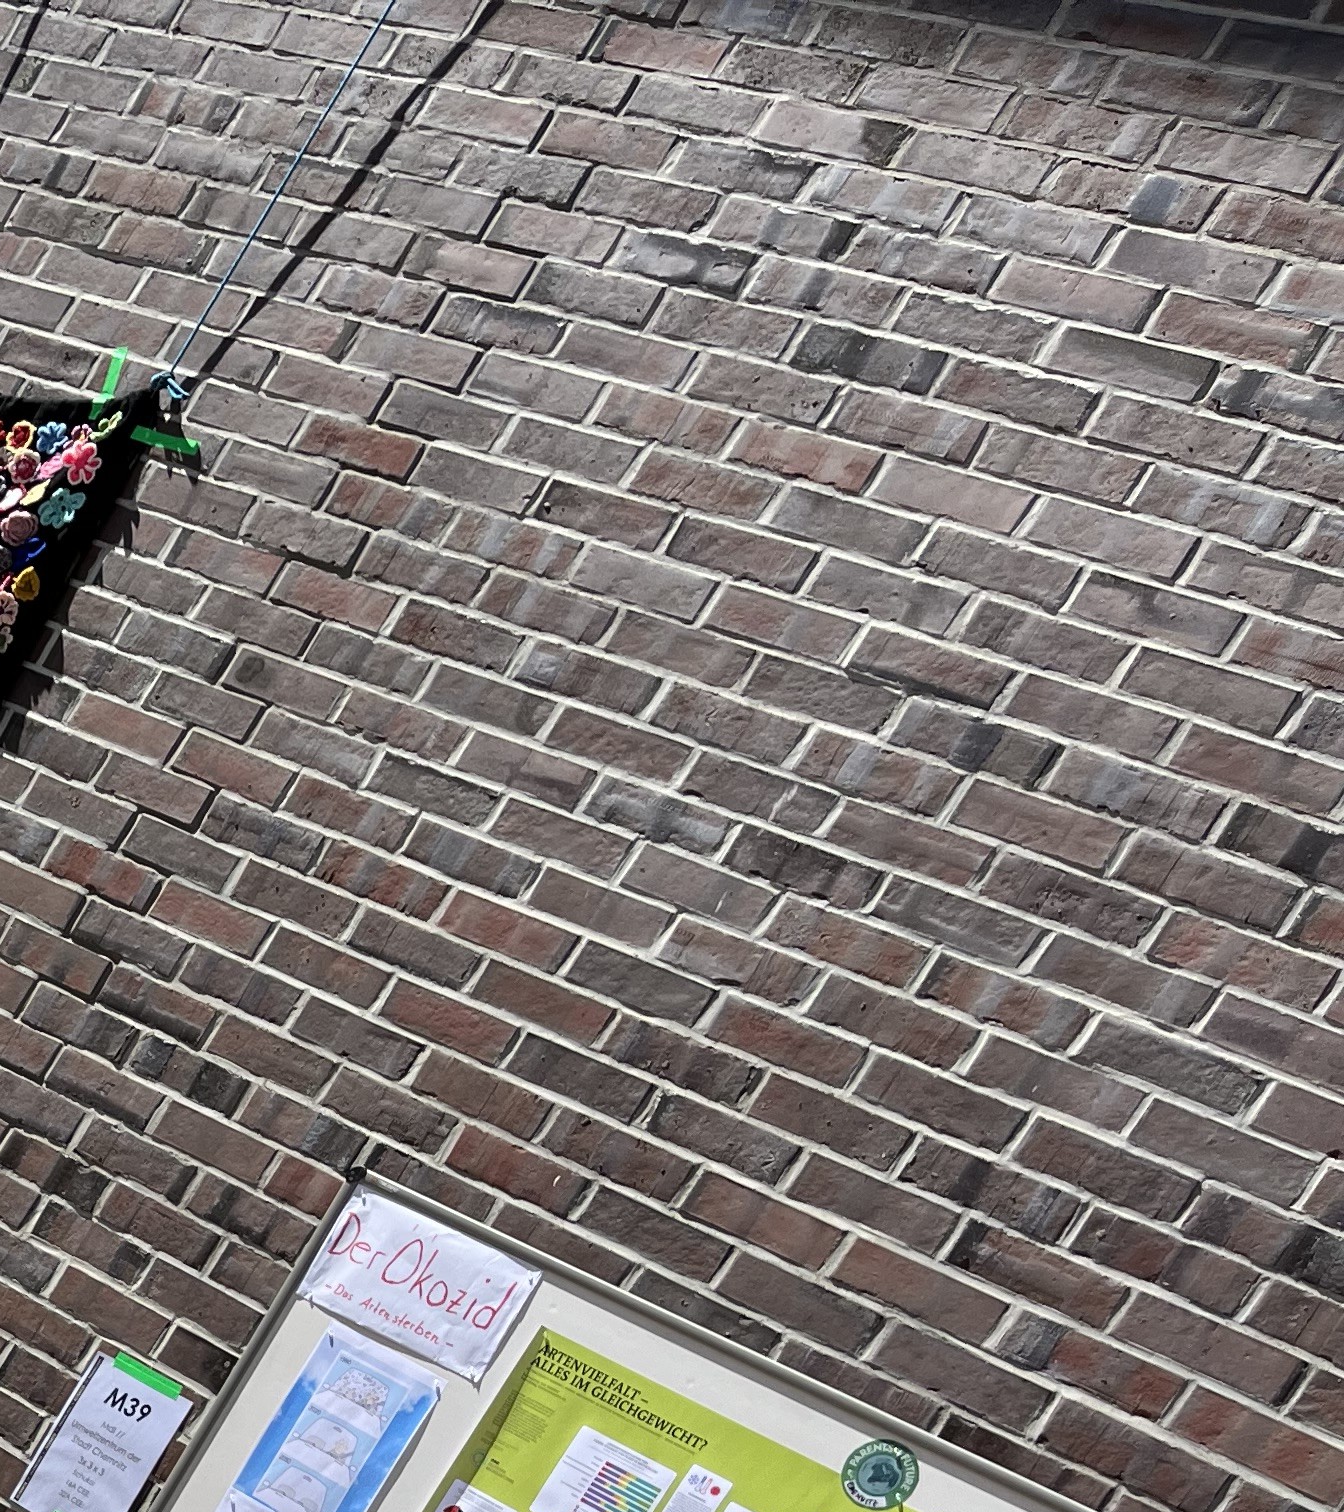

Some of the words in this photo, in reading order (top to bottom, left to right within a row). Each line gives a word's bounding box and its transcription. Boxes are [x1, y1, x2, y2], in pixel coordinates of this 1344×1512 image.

[328, 1211, 387, 1269] Der
[381, 1224, 517, 1330] Ökozid
[333, 1284, 353, 1301] Das
[538, 1344, 641, 1401] ARTENVIELFALT
[103, 1388, 152, 1422] M39
[530, 1357, 569, 1381] ALLES
[571, 1374, 589, 1393] IM
[591, 1386, 708, 1452] GLEICHGEWICHT?
[71, 1435, 92, 1451] Stadt
[91, 1446, 127, 1472] Chemnitz
[901, 1453, 915, 1491] FUTURE
